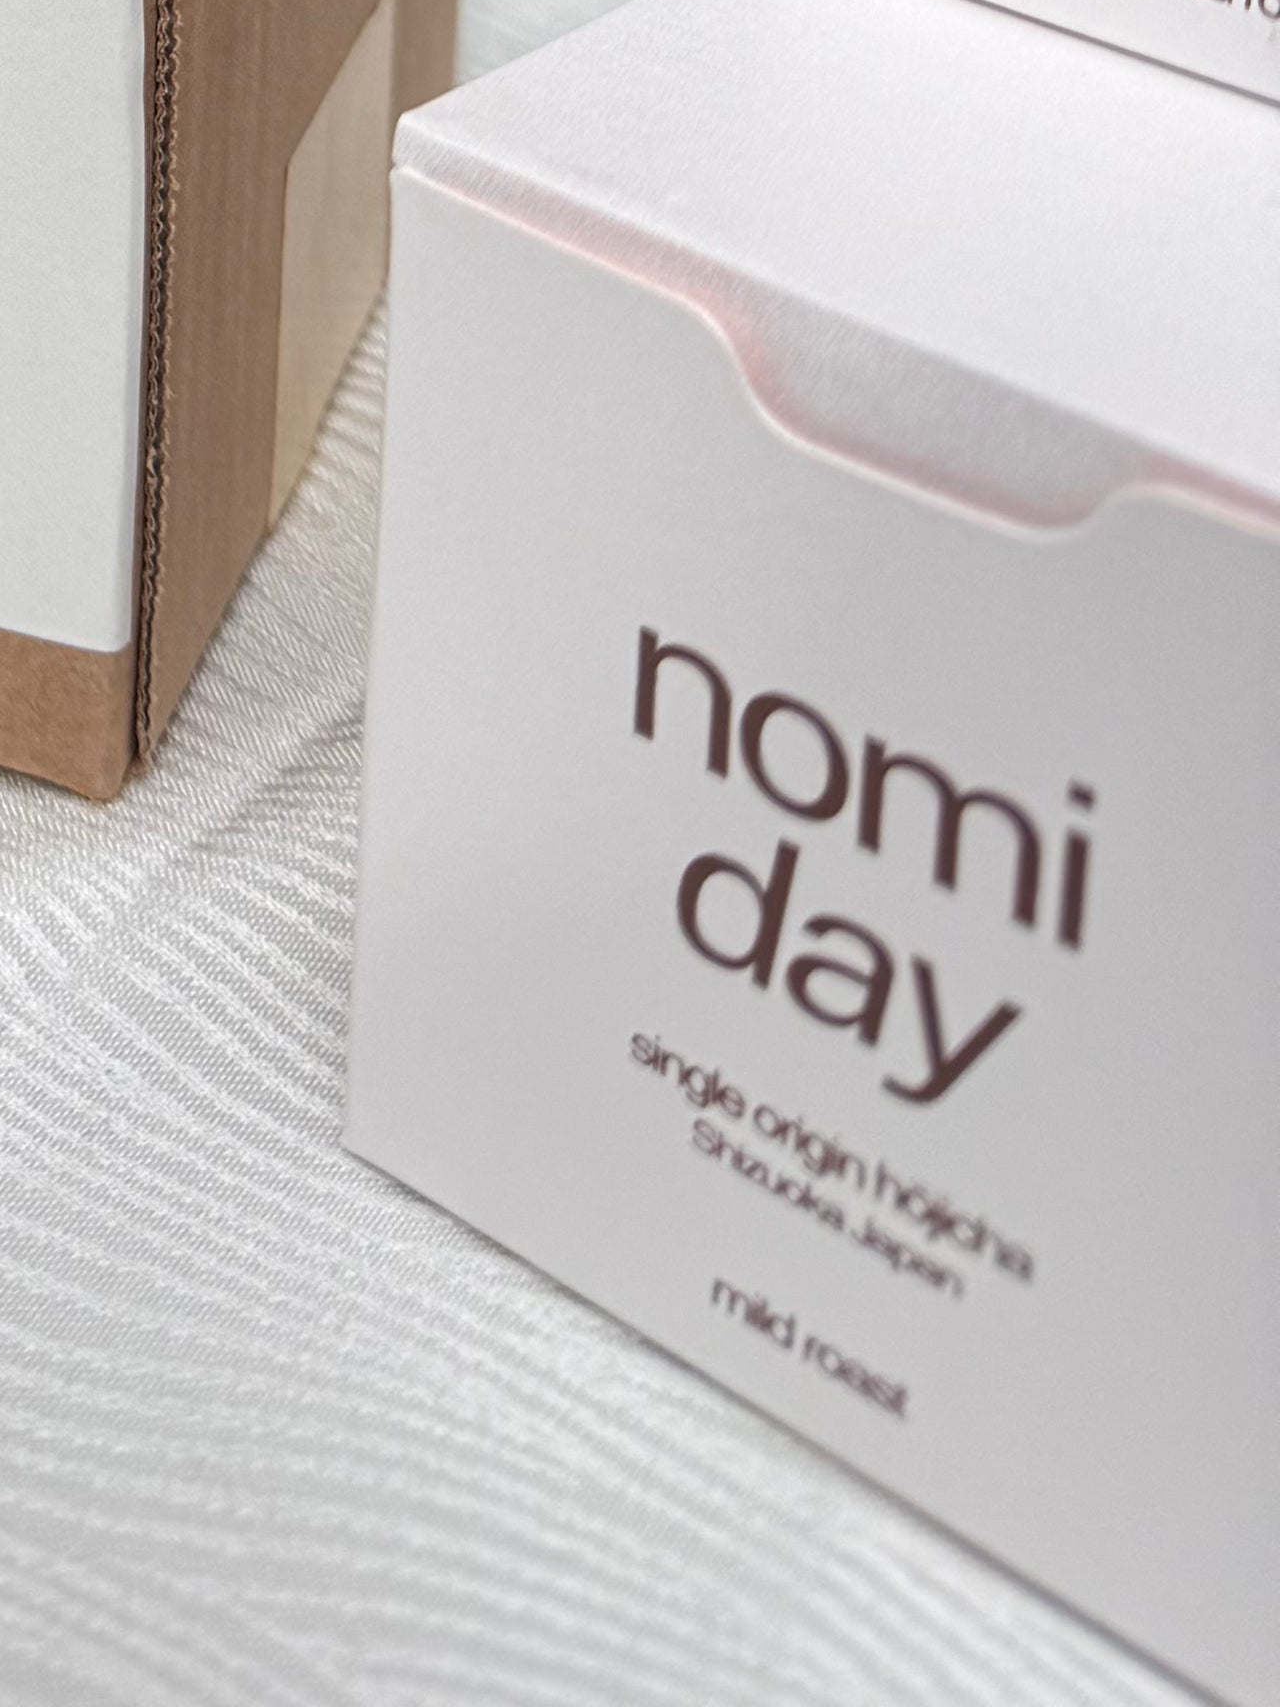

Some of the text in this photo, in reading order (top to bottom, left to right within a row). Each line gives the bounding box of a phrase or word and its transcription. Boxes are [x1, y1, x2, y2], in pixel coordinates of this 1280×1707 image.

[633, 624, 1096, 953] nomi
[676, 836, 1025, 1106] day
[630, 1031, 746, 1120] single
[753, 1103, 867, 1190] origin
[711, 1277, 909, 1419] mild roast
